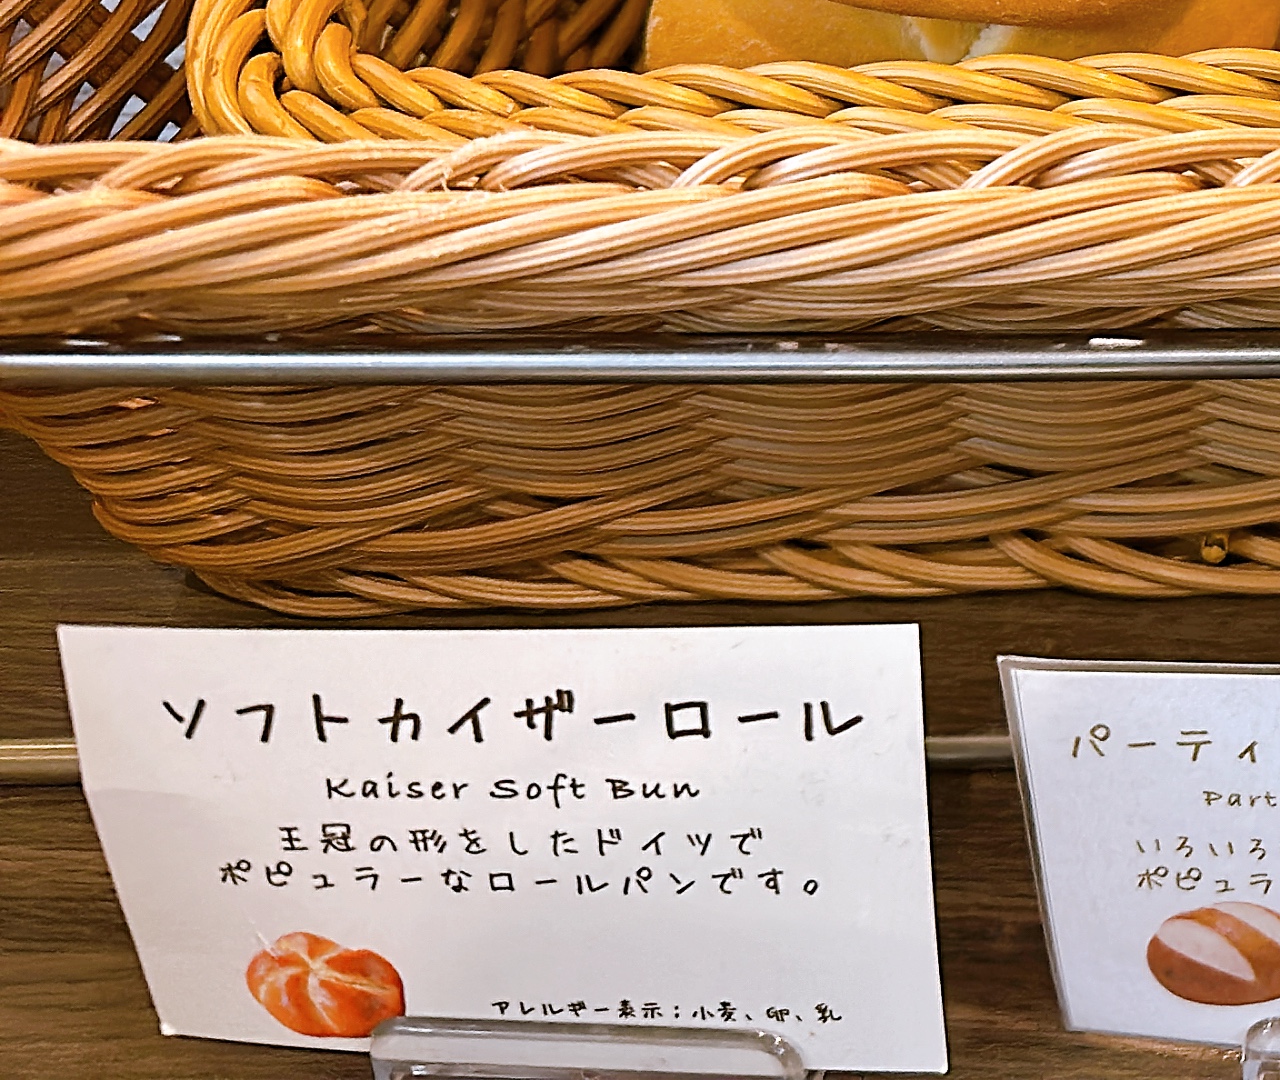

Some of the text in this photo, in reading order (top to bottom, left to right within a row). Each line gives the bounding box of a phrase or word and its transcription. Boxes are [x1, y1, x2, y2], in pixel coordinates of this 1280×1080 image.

[161, 687, 866, 745] ソフトカイザーロール
[324, 769, 702, 811] Kaiser Soft Bun
[277, 821, 764, 856] 王冠の形をしたドイツで
